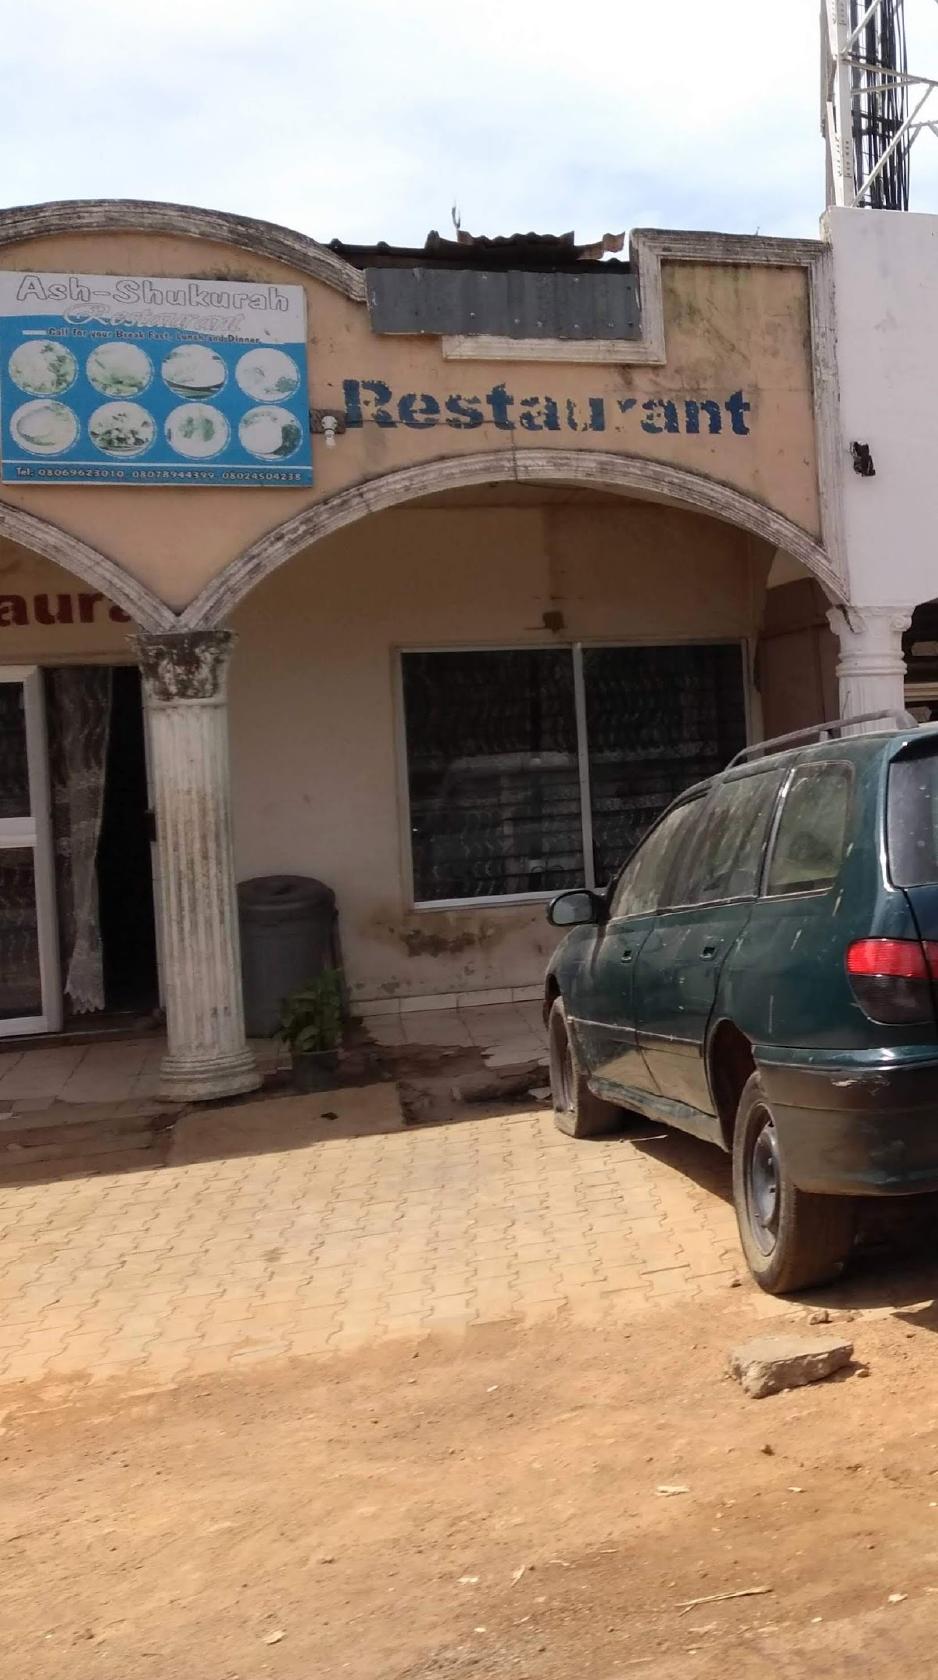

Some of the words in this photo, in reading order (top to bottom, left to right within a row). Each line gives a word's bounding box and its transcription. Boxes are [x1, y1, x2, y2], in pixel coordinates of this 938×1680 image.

[16, 275, 290, 312] Ash-Shukurah
[48, 327, 68, 337] Call
[73, 328, 87, 337] for
[91, 329, 112, 339] your
[116, 330, 145, 339] Break
[63, 302, 247, 332] Restaurant
[0, 593, 132, 627] aur
